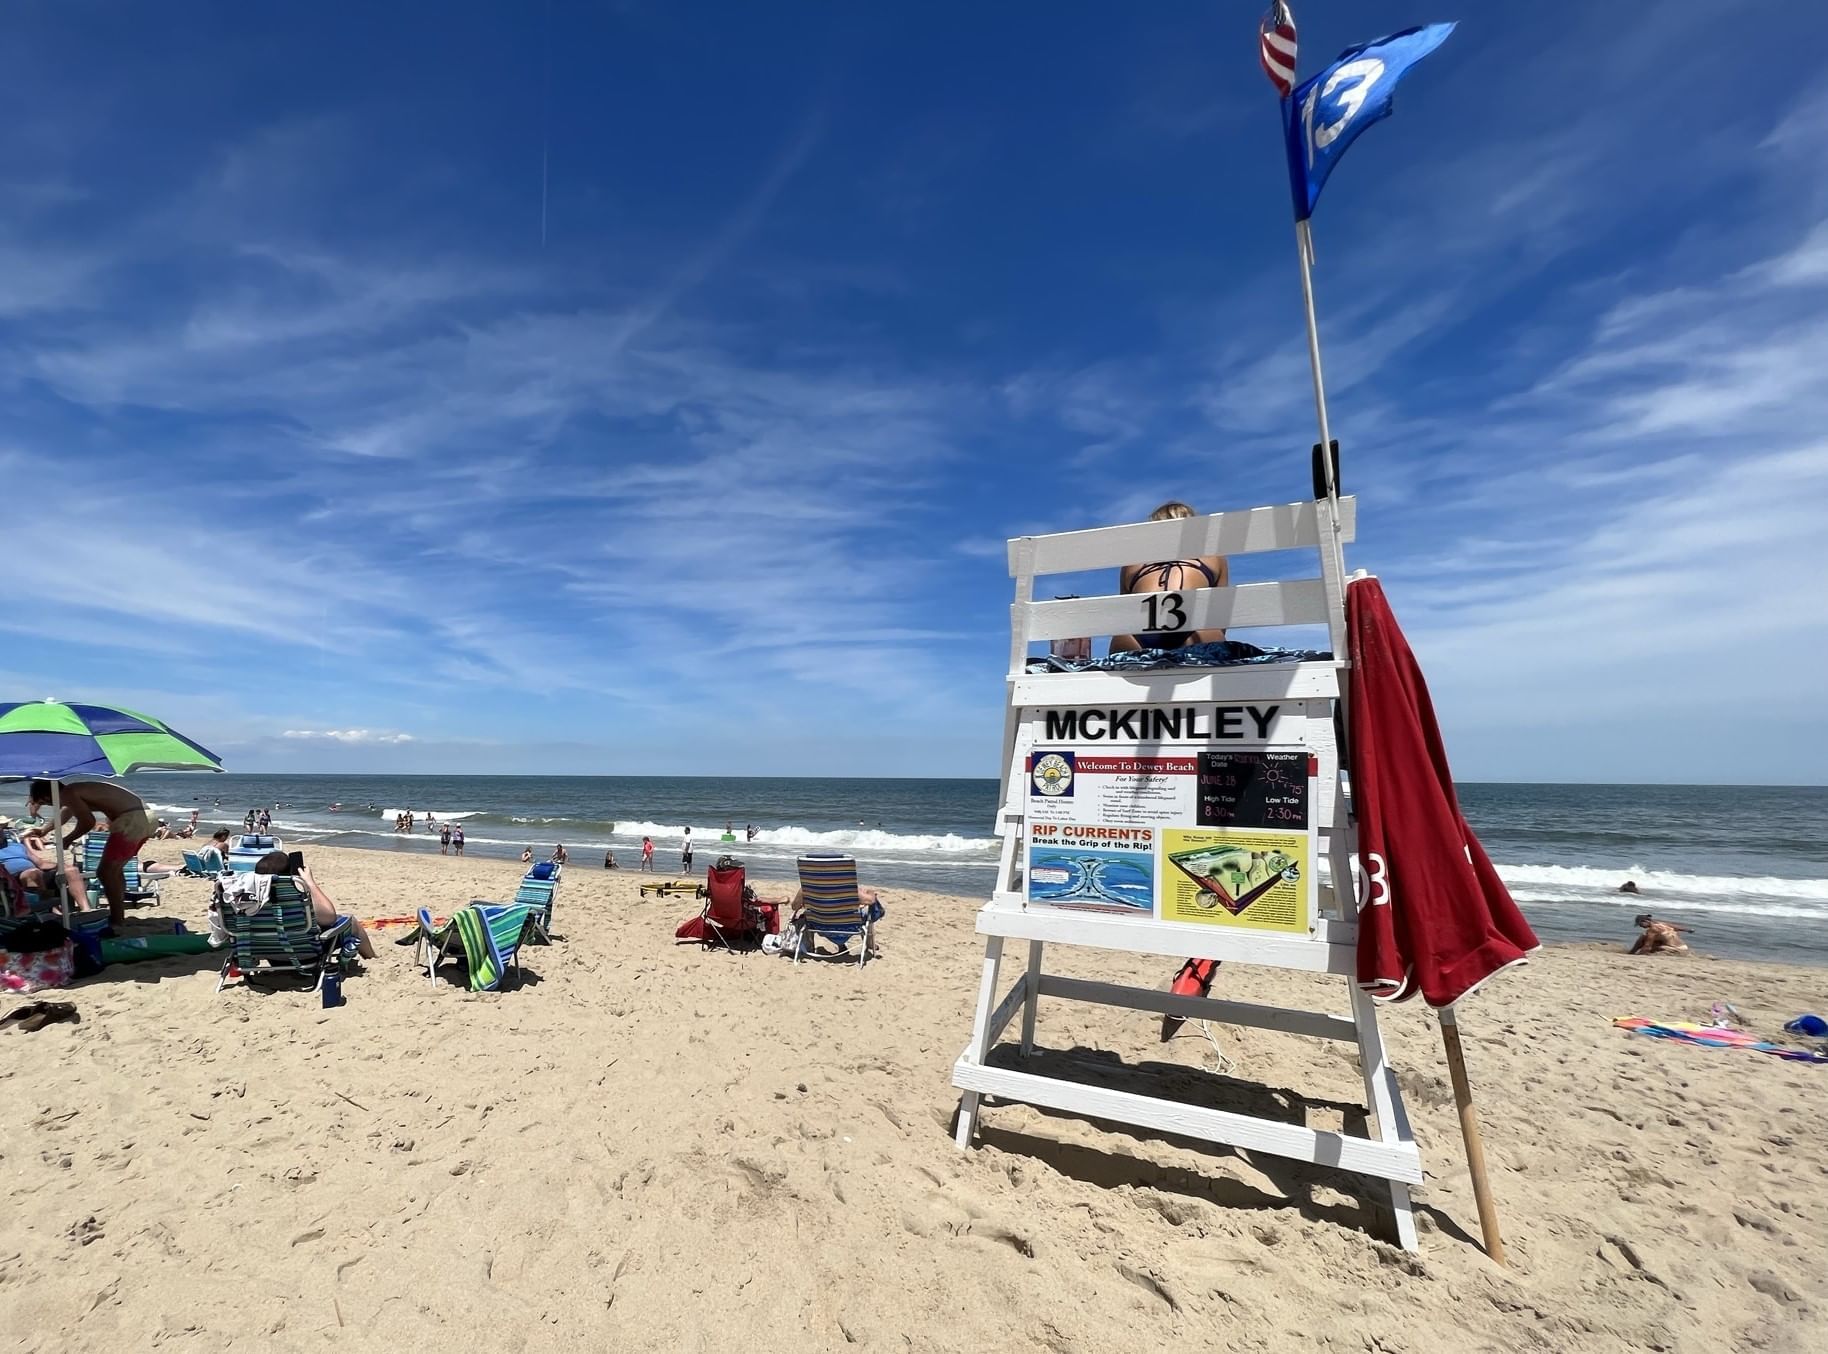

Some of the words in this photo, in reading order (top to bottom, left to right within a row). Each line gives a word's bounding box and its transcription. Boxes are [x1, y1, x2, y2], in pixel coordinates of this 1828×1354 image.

[1302, 58, 1385, 171] 13
[1141, 593, 1187, 633] 13
[1045, 705, 1280, 741] MCKINLEY
[1078, 761, 1117, 770] Welcome
[1119, 762, 1131, 770] To
[1134, 762, 1164, 773] Dewey
[1166, 762, 1194, 771] Beach
[1204, 795, 1220, 803] High
[1267, 807, 1292, 819] 2:30
[1032, 825, 1058, 836] RIP
[1063, 826, 1152, 841] CURRENTS
[1032, 837, 1058, 845] Break
[1061, 838, 1076, 846] the
[1079, 840, 1099, 848] Grip
[1133, 843, 1152, 851] Rip!
